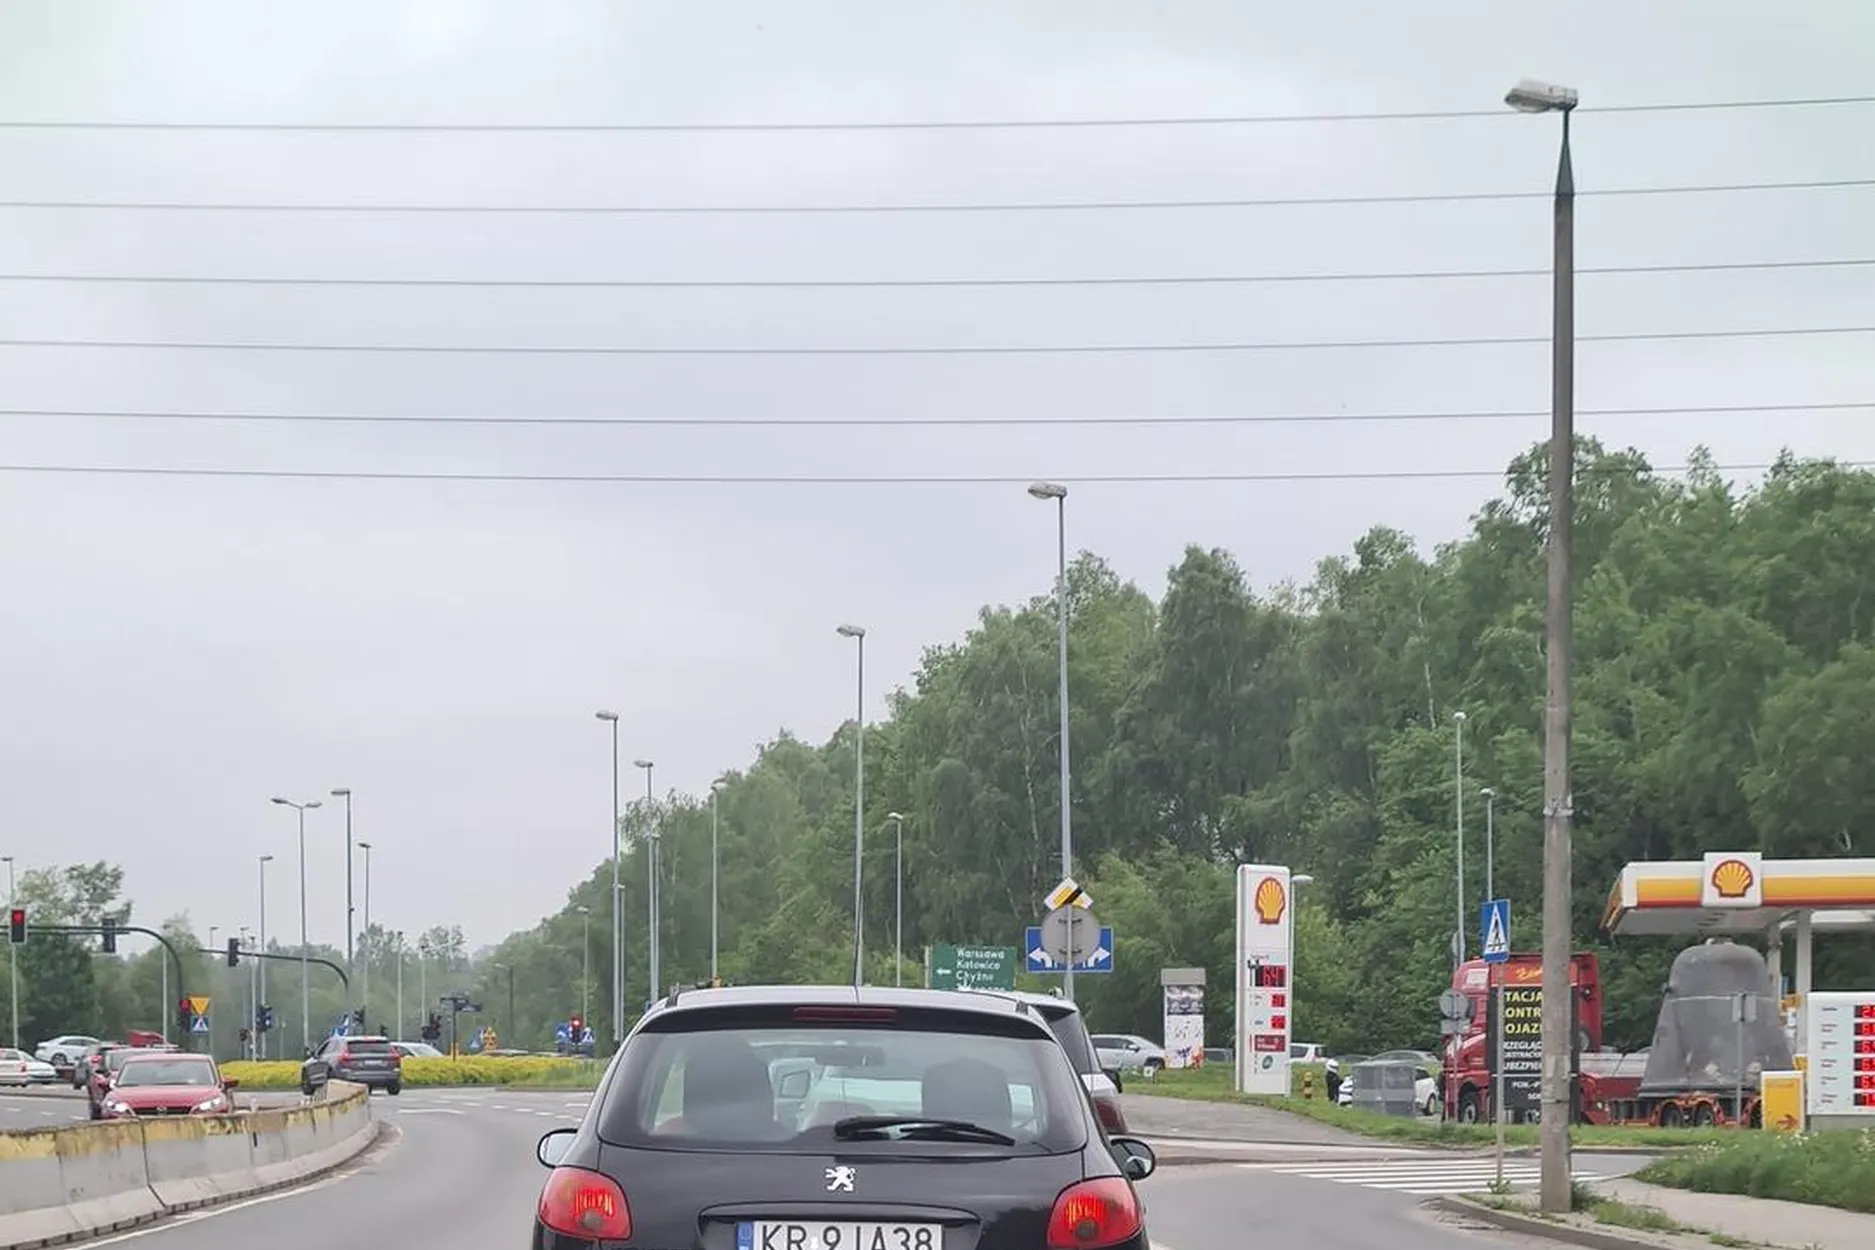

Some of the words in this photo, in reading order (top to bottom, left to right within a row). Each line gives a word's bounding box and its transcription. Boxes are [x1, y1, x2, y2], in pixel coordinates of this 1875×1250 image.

[1504, 991, 1543, 1002] TACJA
[1505, 1007, 1541, 1018] ONTR
[1505, 1023, 1542, 1034] OJAZ
